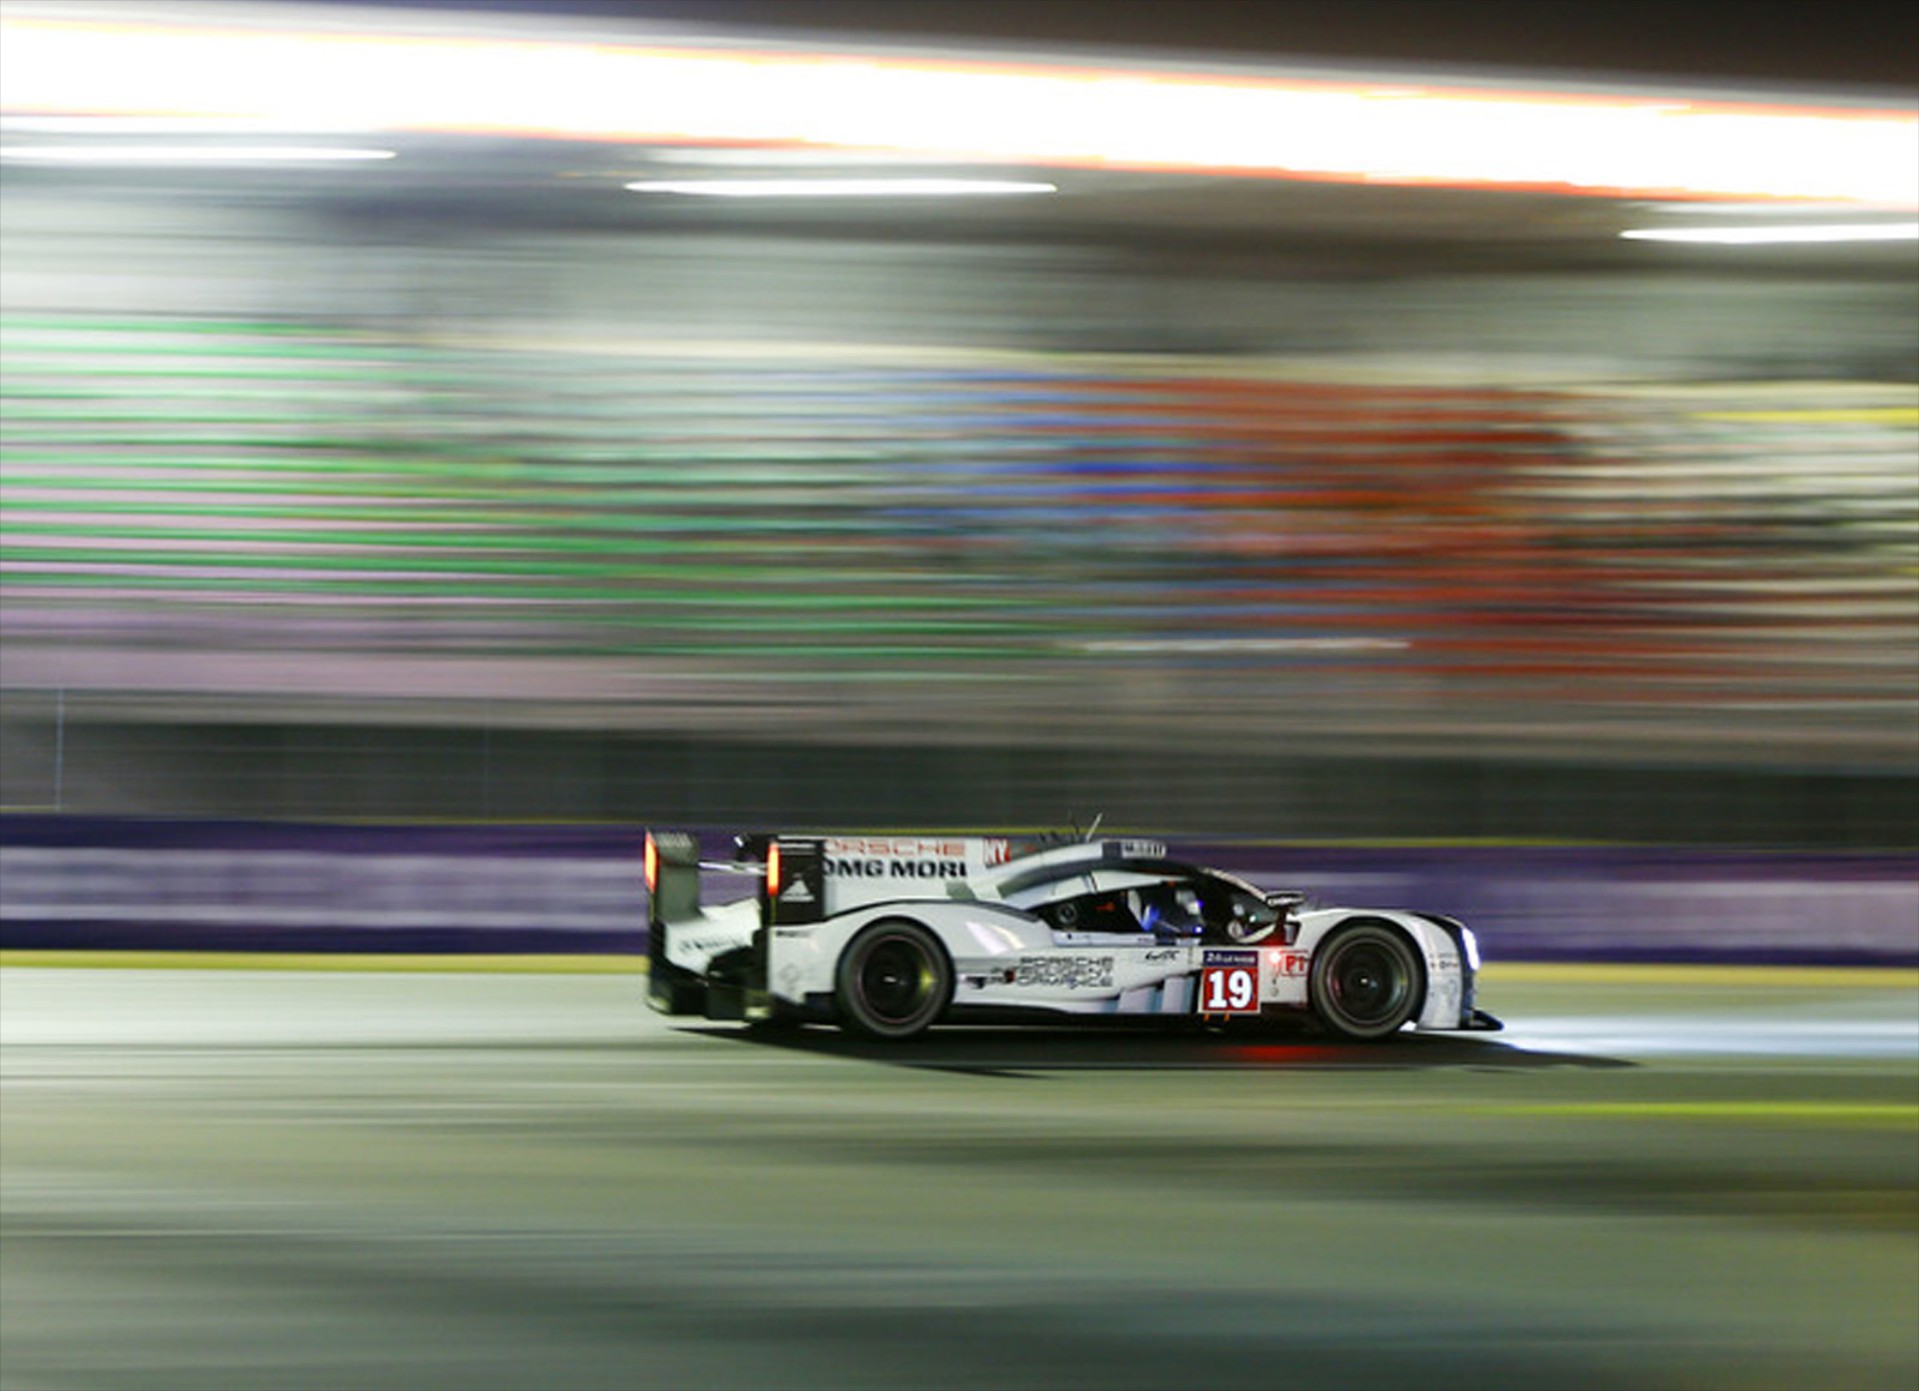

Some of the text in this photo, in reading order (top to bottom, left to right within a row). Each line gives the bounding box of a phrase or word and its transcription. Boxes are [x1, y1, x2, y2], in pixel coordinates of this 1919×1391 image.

[823, 838, 966, 856] ORSCHE
[890, 859, 968, 878] MORI
[1208, 969, 1253, 1009] 19
